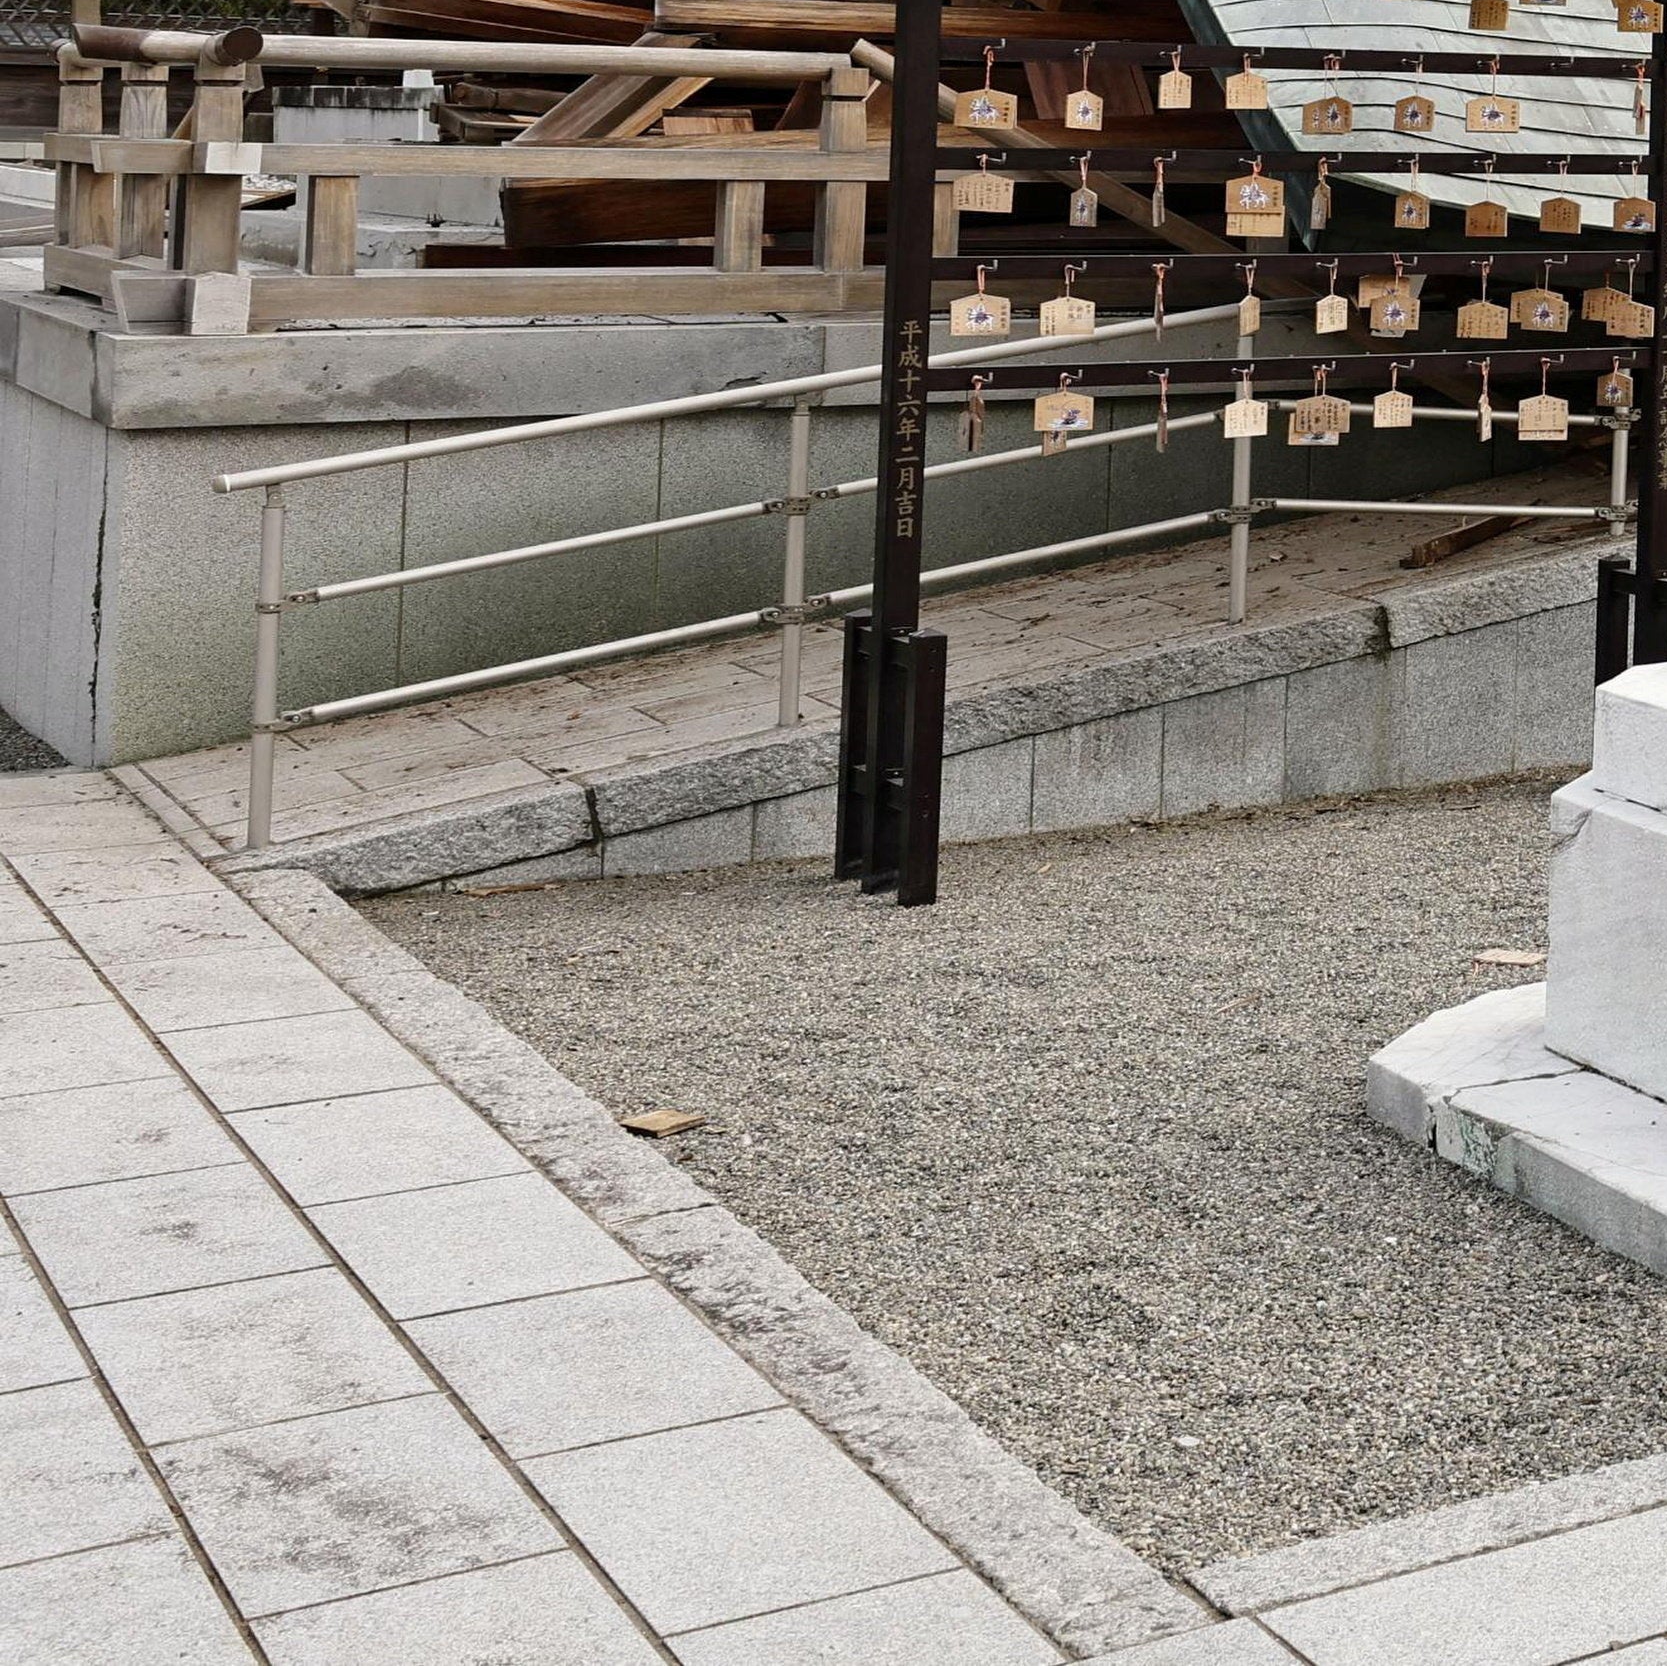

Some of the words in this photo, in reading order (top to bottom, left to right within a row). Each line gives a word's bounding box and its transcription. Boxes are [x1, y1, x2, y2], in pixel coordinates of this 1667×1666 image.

[894, 319, 923, 538] 平成十六年二月吉日
